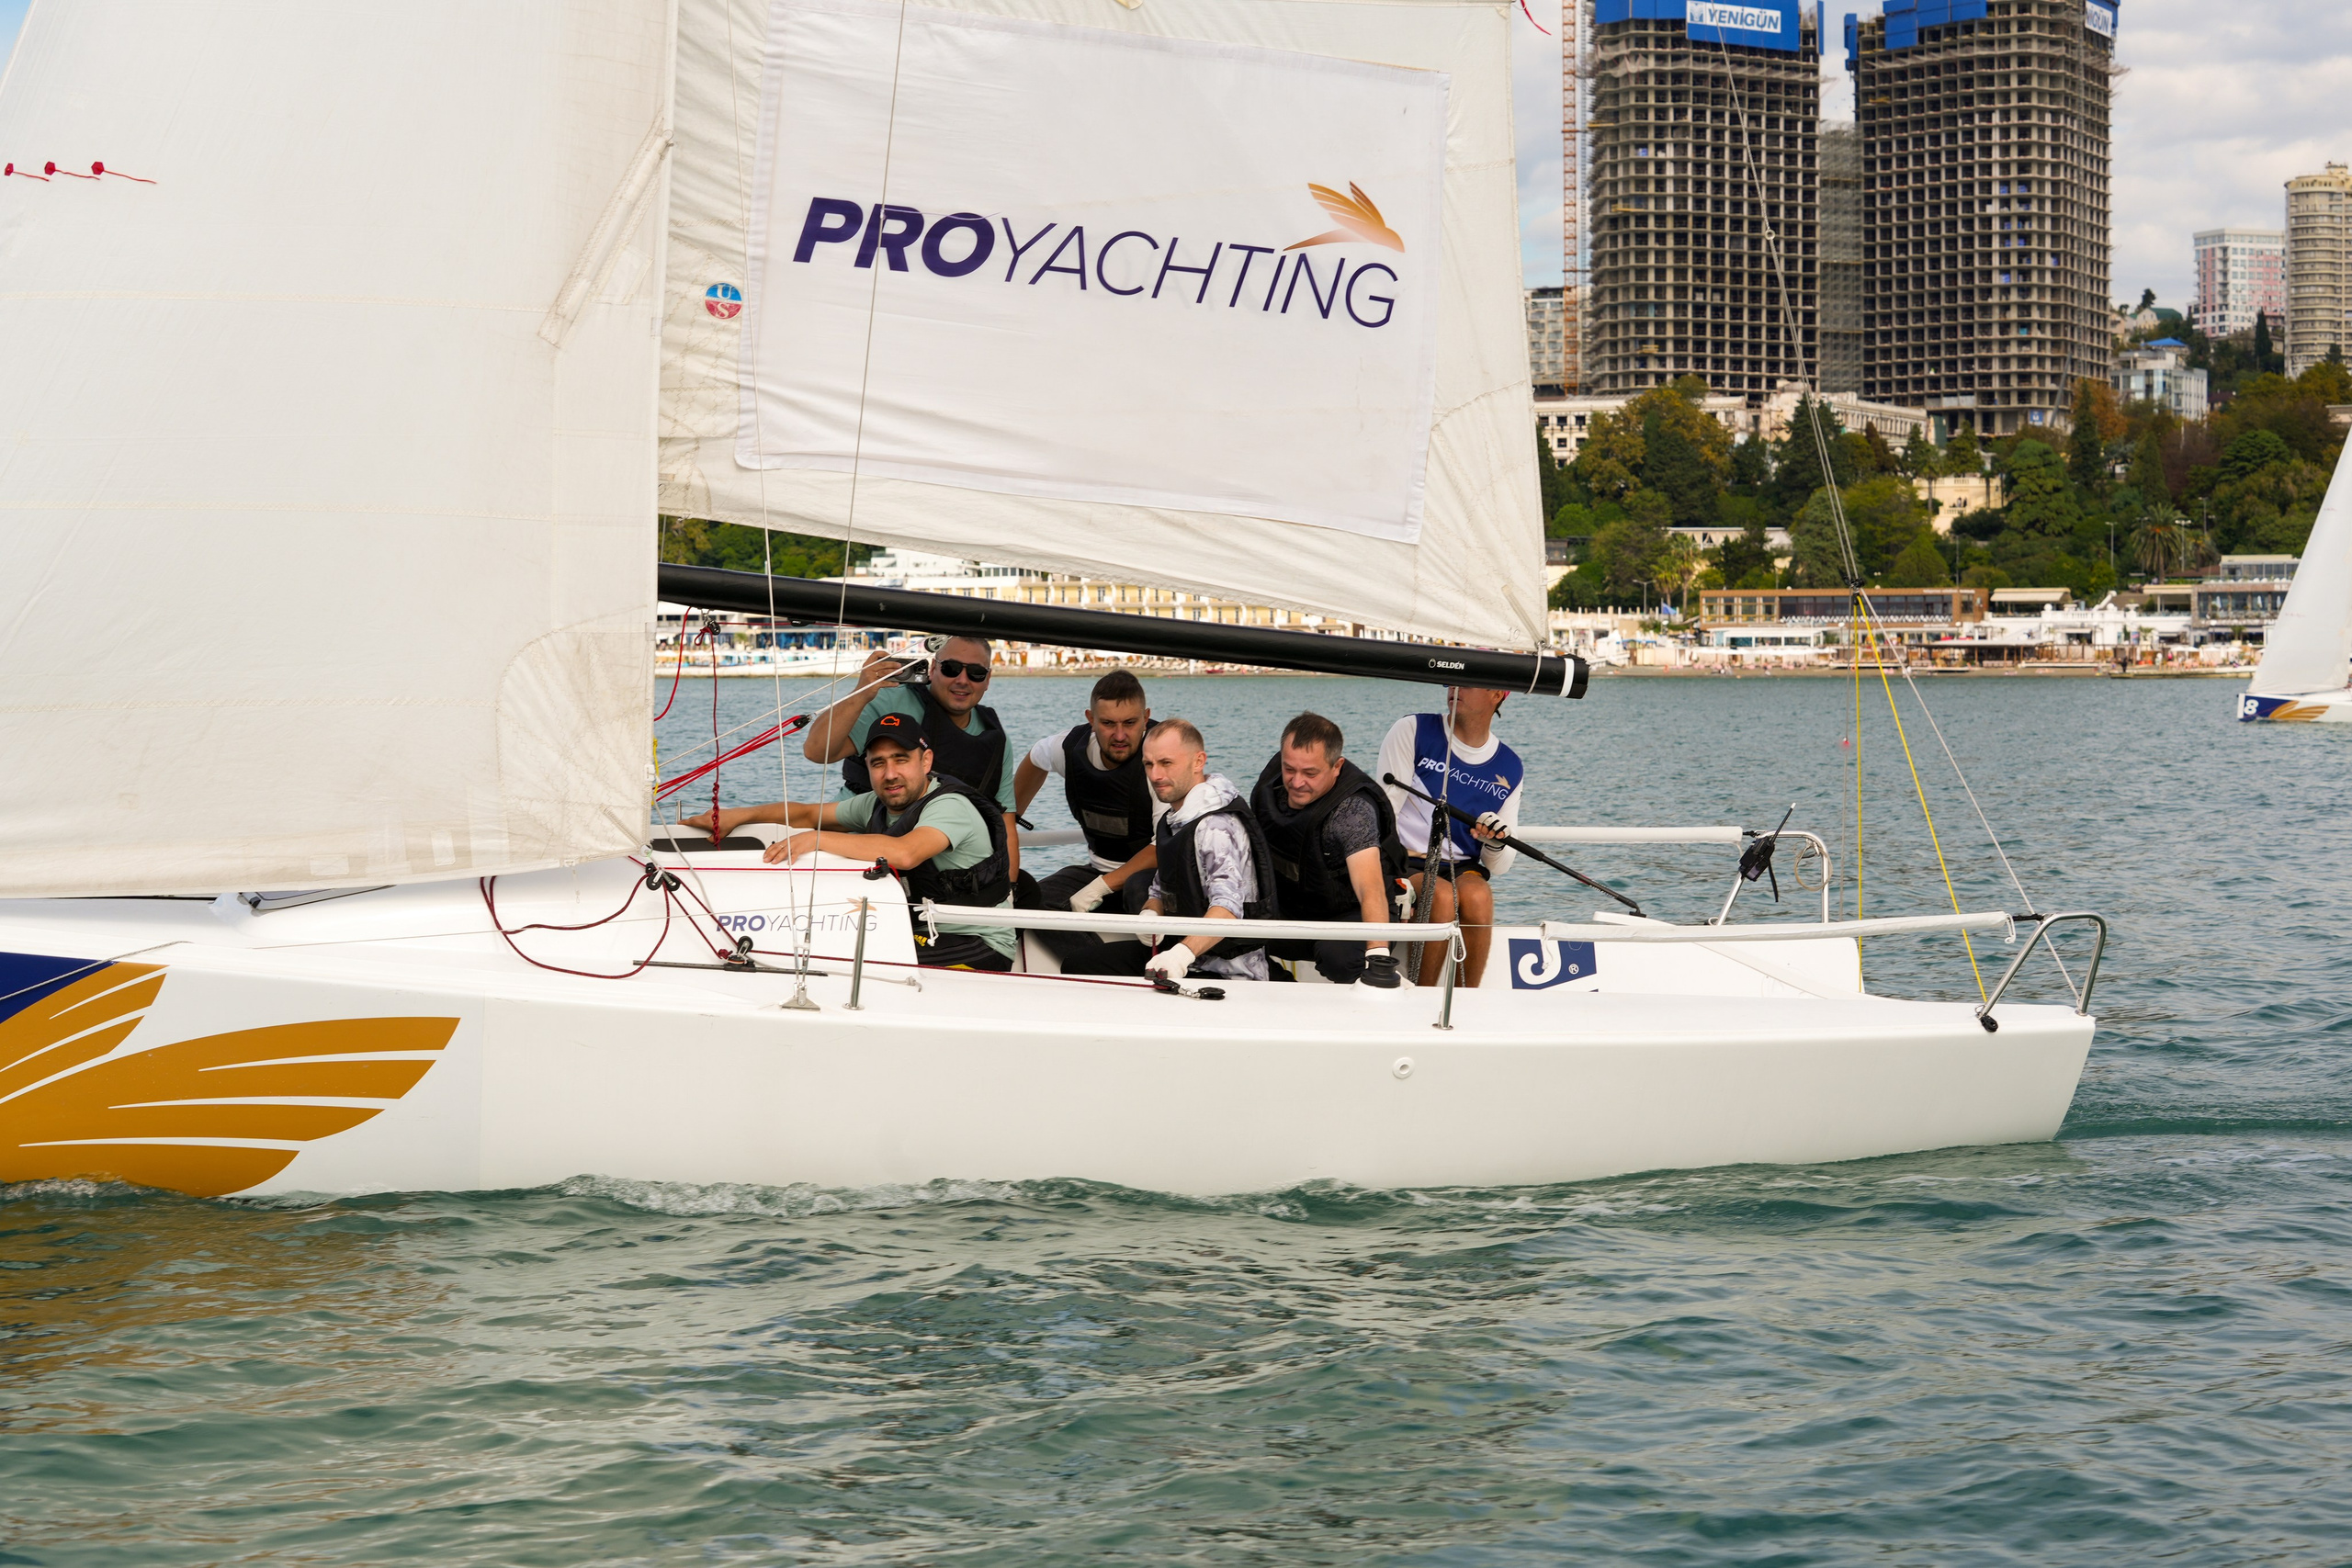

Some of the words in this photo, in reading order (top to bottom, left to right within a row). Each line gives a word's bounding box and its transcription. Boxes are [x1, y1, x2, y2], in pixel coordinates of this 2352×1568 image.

[1708, 8, 1779, 29] YENİGÜN
[792, 197, 1399, 329] PROYACHTING
[1437, 660, 1464, 670] SELDÉN
[2245, 699, 2259, 715] 8
